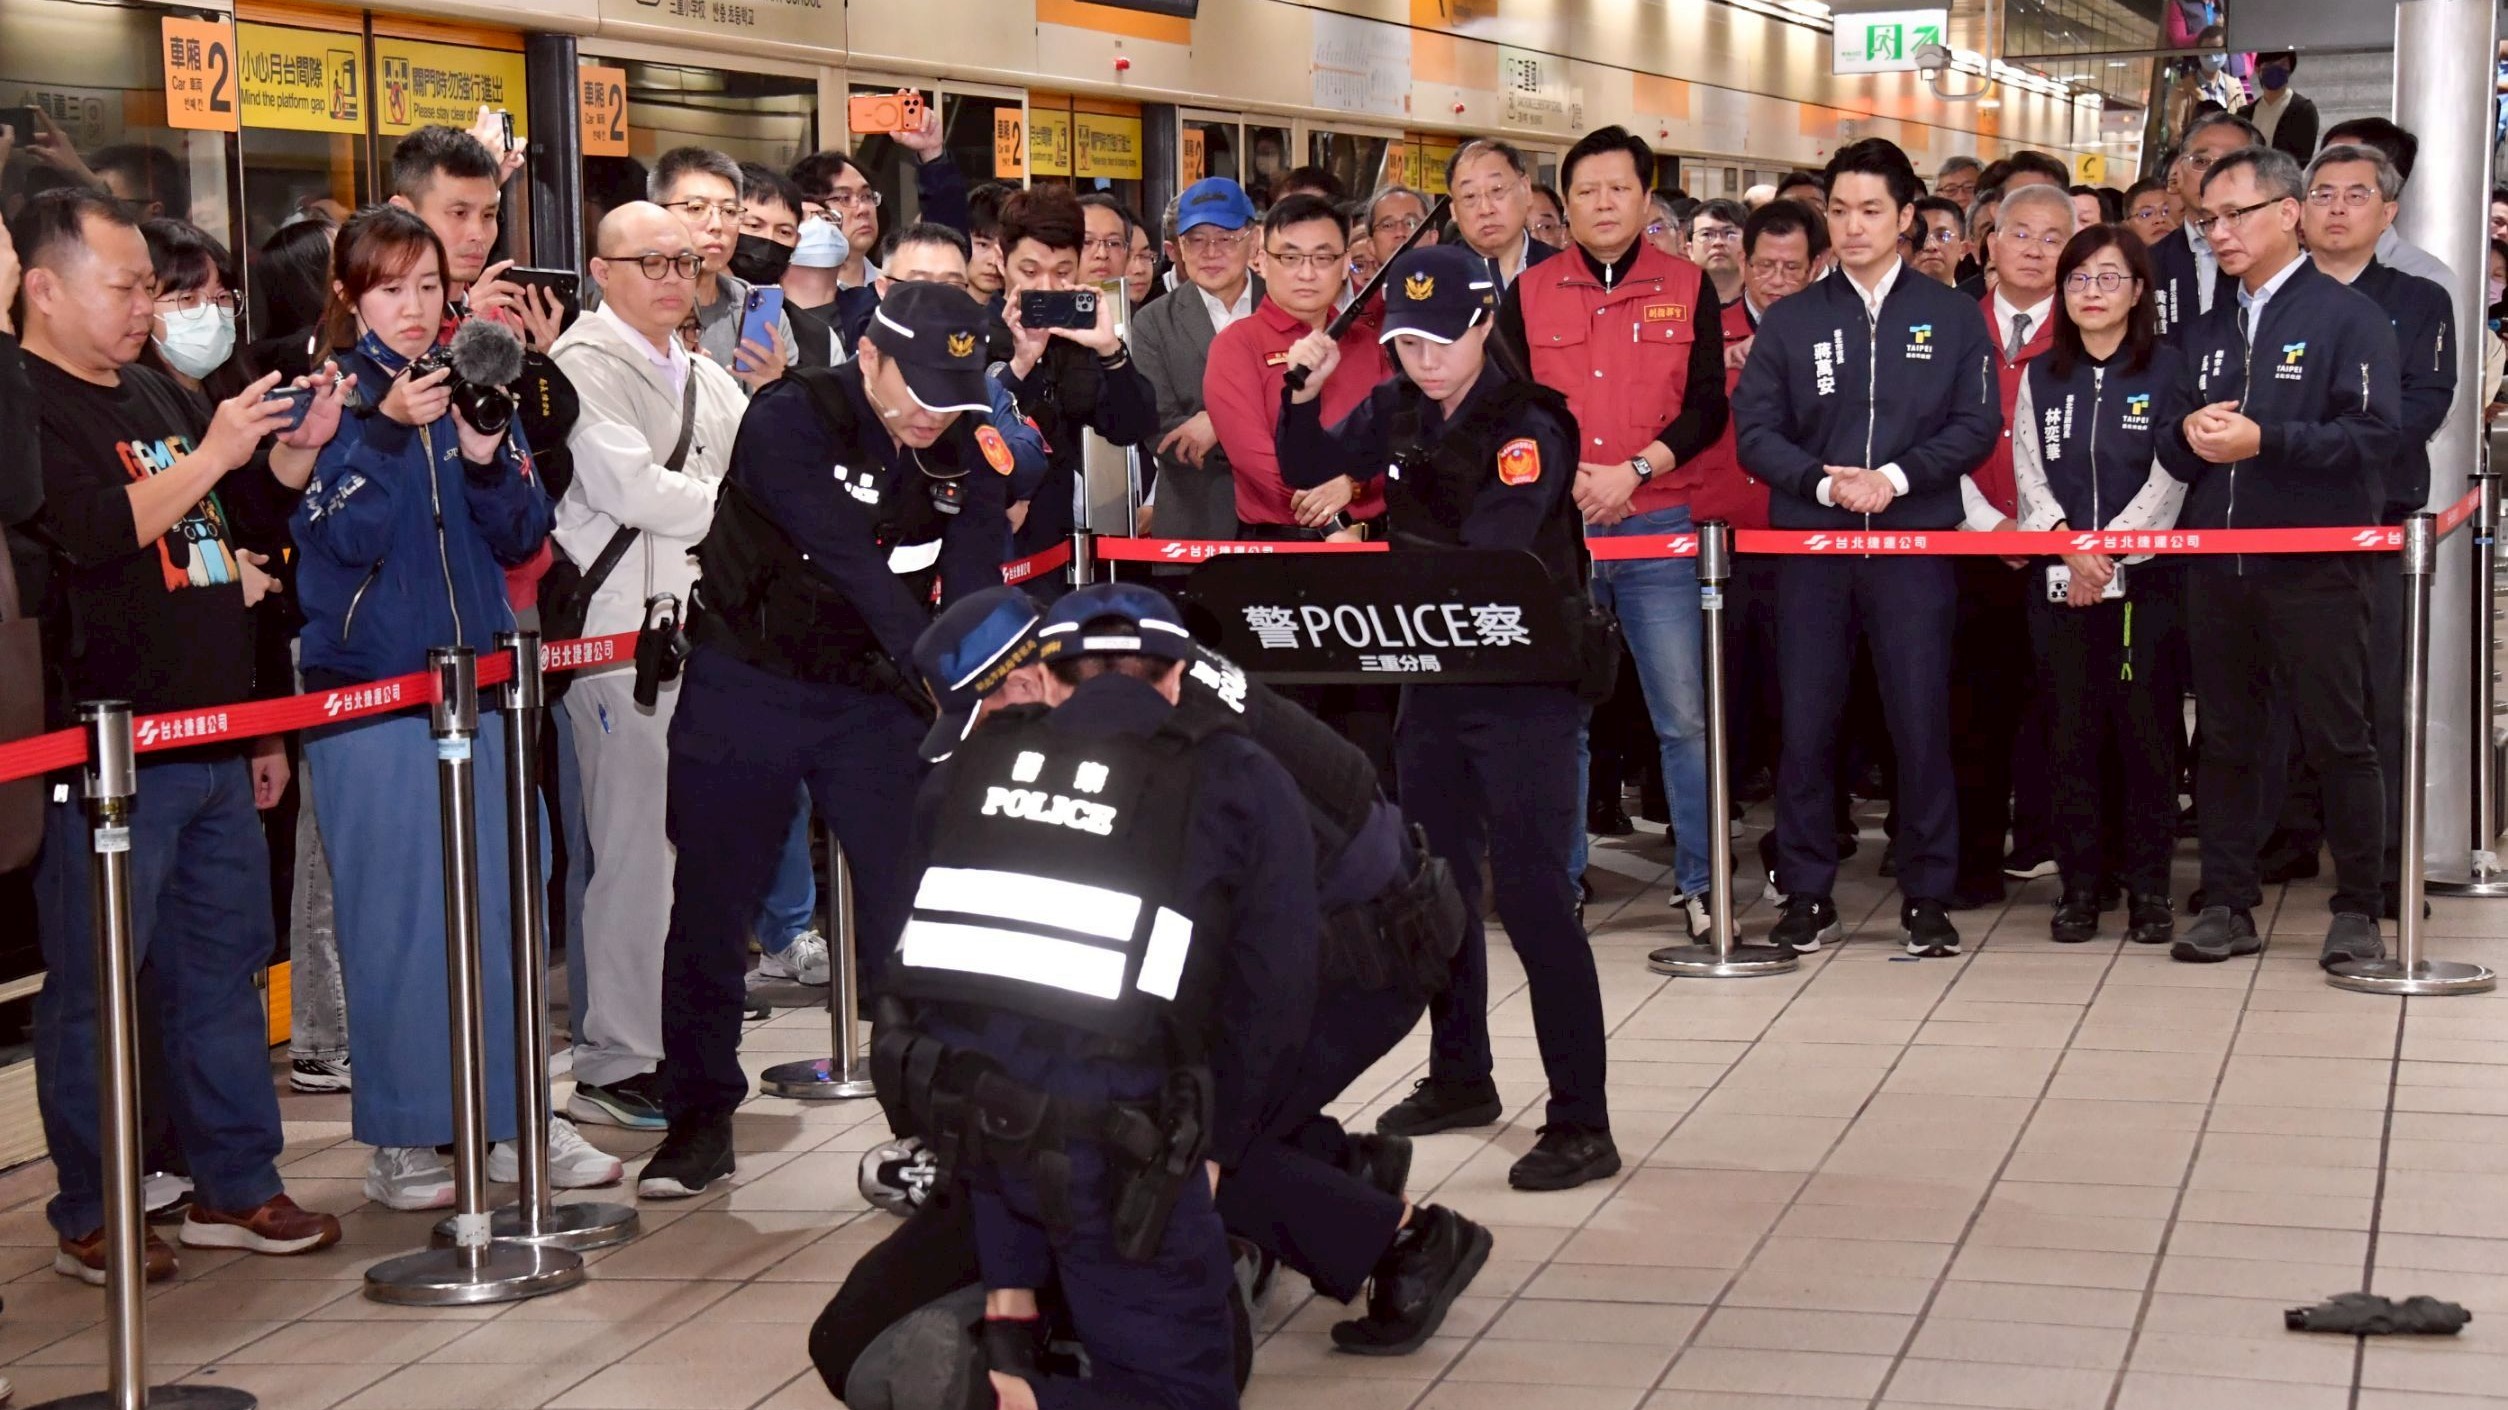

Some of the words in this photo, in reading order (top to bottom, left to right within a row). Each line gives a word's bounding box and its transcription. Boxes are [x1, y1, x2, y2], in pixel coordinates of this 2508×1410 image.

[170, 36, 202, 71] 車廂
[208, 42, 231, 113] 2
[241, 51, 324, 88] 小心月台間隙
[172, 76, 186, 91] Car
[412, 67, 504, 103] 關門時勿強行進出
[240, 89, 261, 106] Mind
[262, 93, 276, 107] the
[277, 94, 309, 111] platform
[311, 98, 325, 115] gap
[413, 102, 435, 118] Please
[436, 106, 450, 123] stay
[451, 107, 467, 121] clear
[467, 109, 475, 121] of
[609, 83, 624, 141] 2
[1012, 121, 1022, 166] 2
[1906, 344, 1932, 353] TAIPEI
[1813, 342, 1835, 396] 蔣萬安
[2276, 365, 2303, 374] TAIPEI
[2122, 415, 2149, 424] TAIPEI
[2044, 407, 2062, 461] 林奕華
[1835, 535, 1927, 550] 台北捷運公司
[2103, 534, 2200, 549] 台北捷運公司
[551, 640, 614, 668] 台北捷運公司
[1359, 655, 1442, 672] 三重分局
[343, 684, 401, 711] 台北捷運公司
[161, 713, 228, 740] 台北捷運公司
[981, 786, 1117, 836] POLICE
